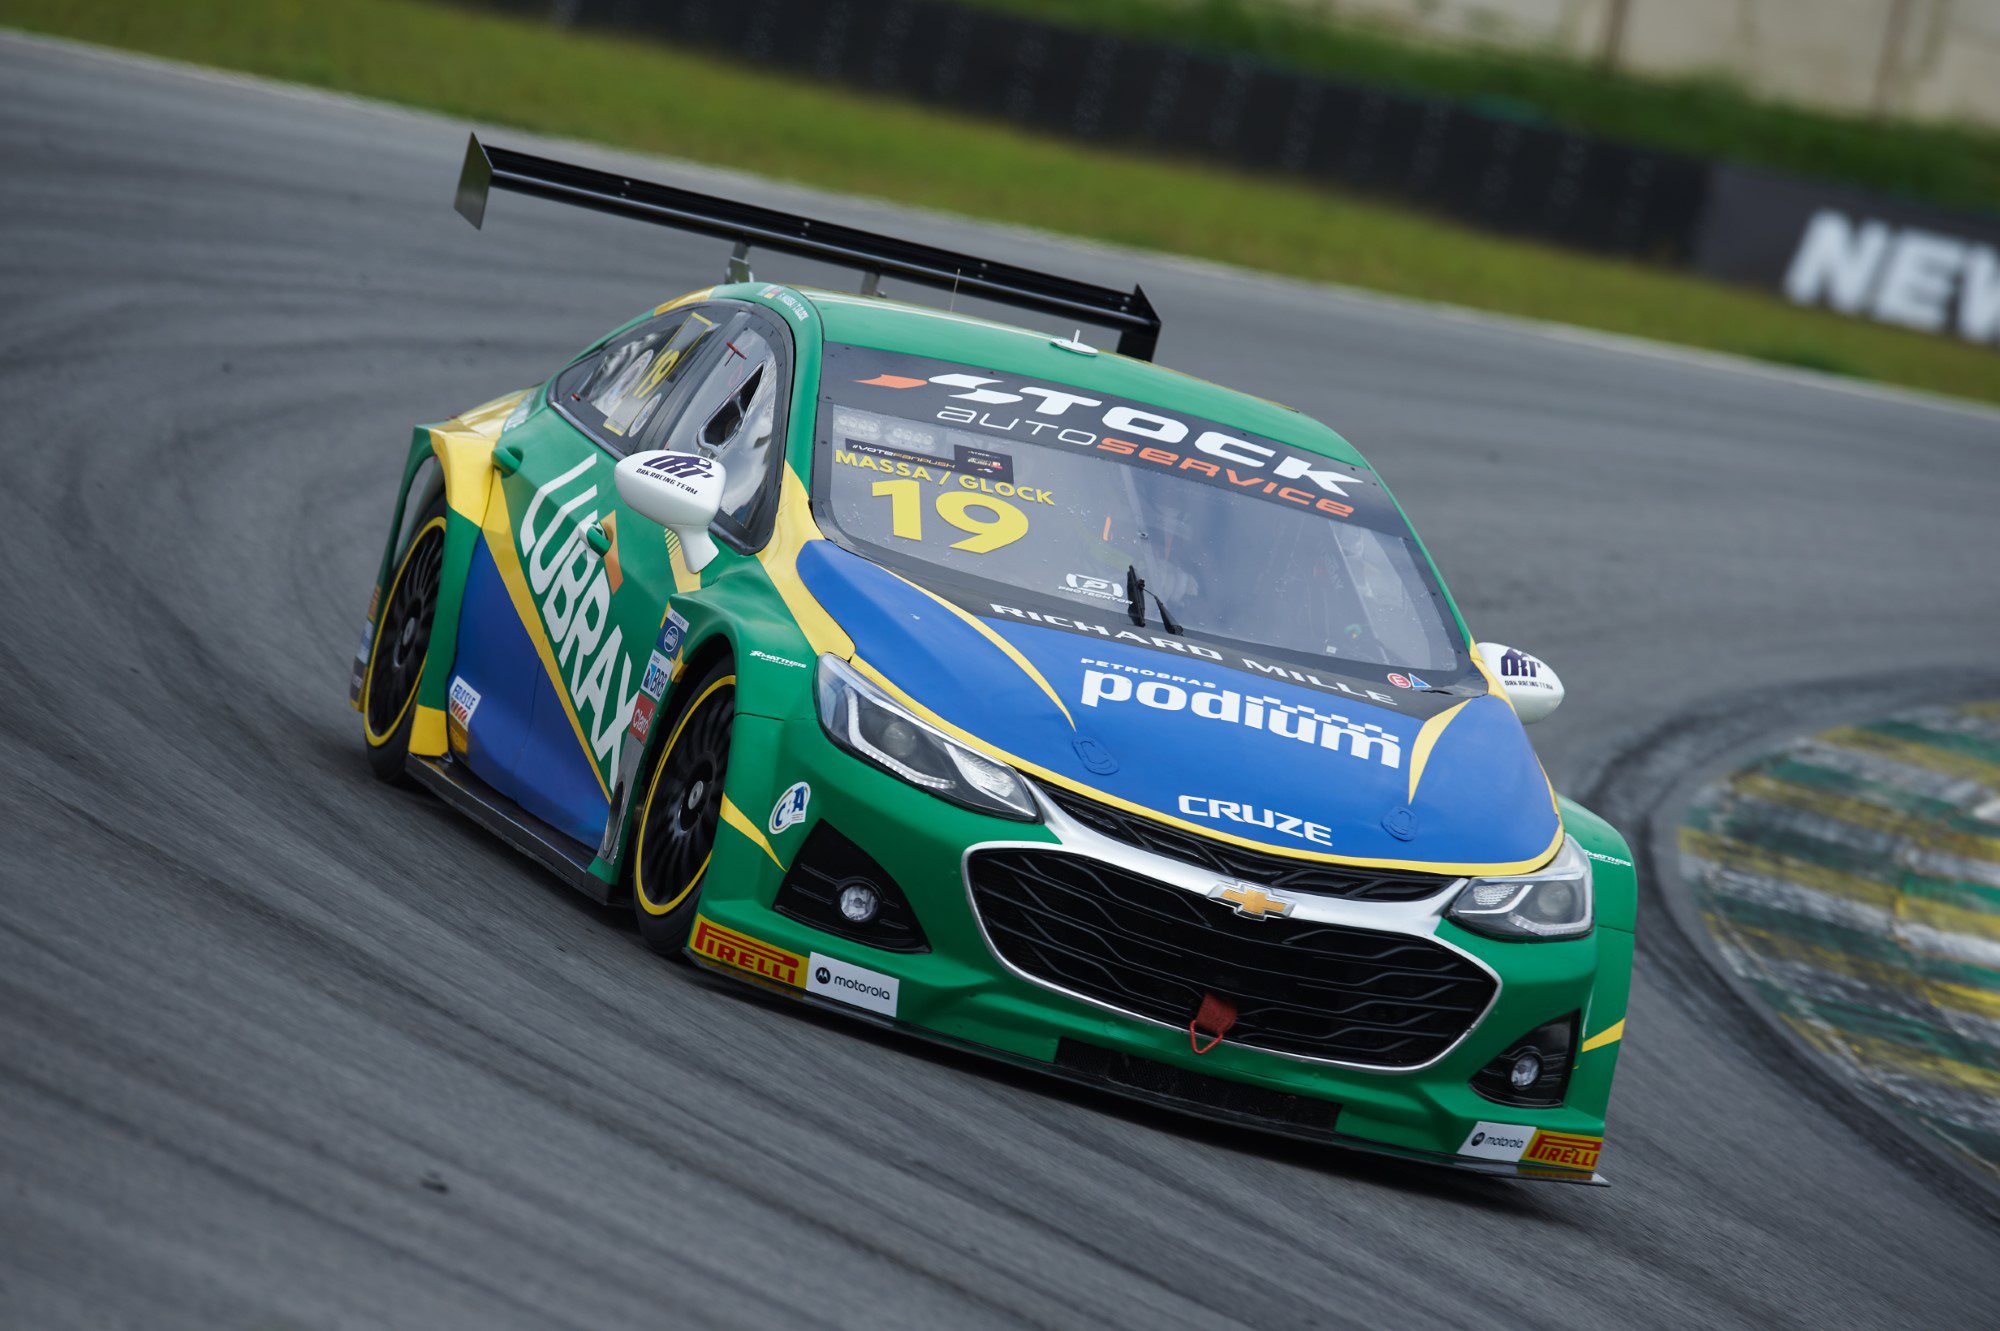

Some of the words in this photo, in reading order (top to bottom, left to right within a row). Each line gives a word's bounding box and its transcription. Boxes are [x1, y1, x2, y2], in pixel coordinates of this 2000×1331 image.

[928, 373, 1364, 497] STOCK
[676, 481, 698, 495] TEAM
[835, 450, 932, 482] MASSA
[939, 471, 951, 485] /
[958, 475, 1055, 506] GLOCK
[872, 479, 1029, 554] 19
[520, 453, 639, 794] LUBRAX
[989, 603, 1223, 661] RICHARD
[1240, 658, 1398, 706] MILLE
[1081, 657, 1216, 689] PETROBRAS
[1081, 669, 1399, 769] podium
[1178, 794, 1334, 847] CRUZE
[696, 921, 799, 984] PIRELLI
[834, 976, 890, 1000] motorola
[1485, 1136, 1524, 1149] motorola
[1529, 1134, 1603, 1167] PIRELLI
